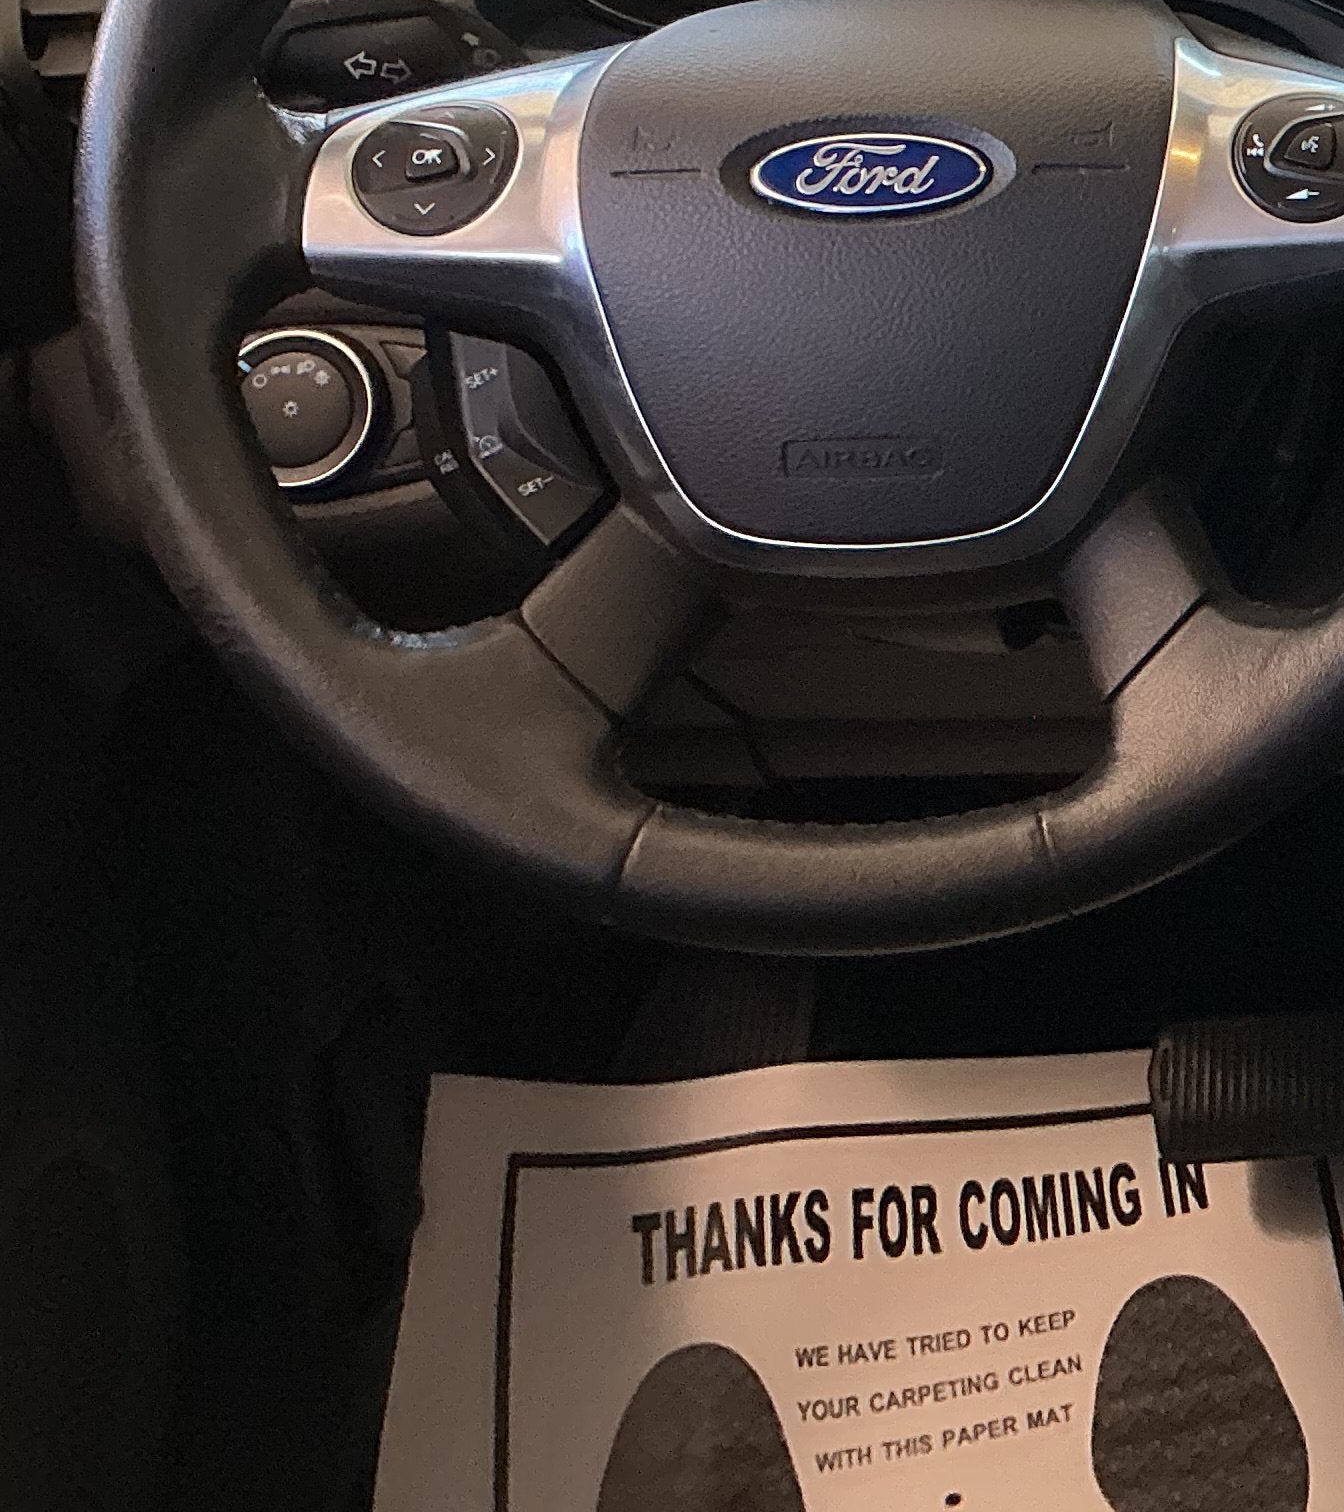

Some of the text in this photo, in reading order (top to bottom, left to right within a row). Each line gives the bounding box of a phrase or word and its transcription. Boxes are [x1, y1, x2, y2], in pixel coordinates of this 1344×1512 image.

[411, 148, 443, 165] OK
[795, 140, 942, 197] Ford
[463, 366, 500, 389] SET+
[631, 1157, 1210, 1286] THANKS FOR COMING IN
[794, 1309, 1077, 1369] WE HAVE TRIED TO KEEP
[797, 1354, 1084, 1425] YOUR CARPETING CLEAN
[814, 1405, 1075, 1474] WITH THIS PAPER MAT
